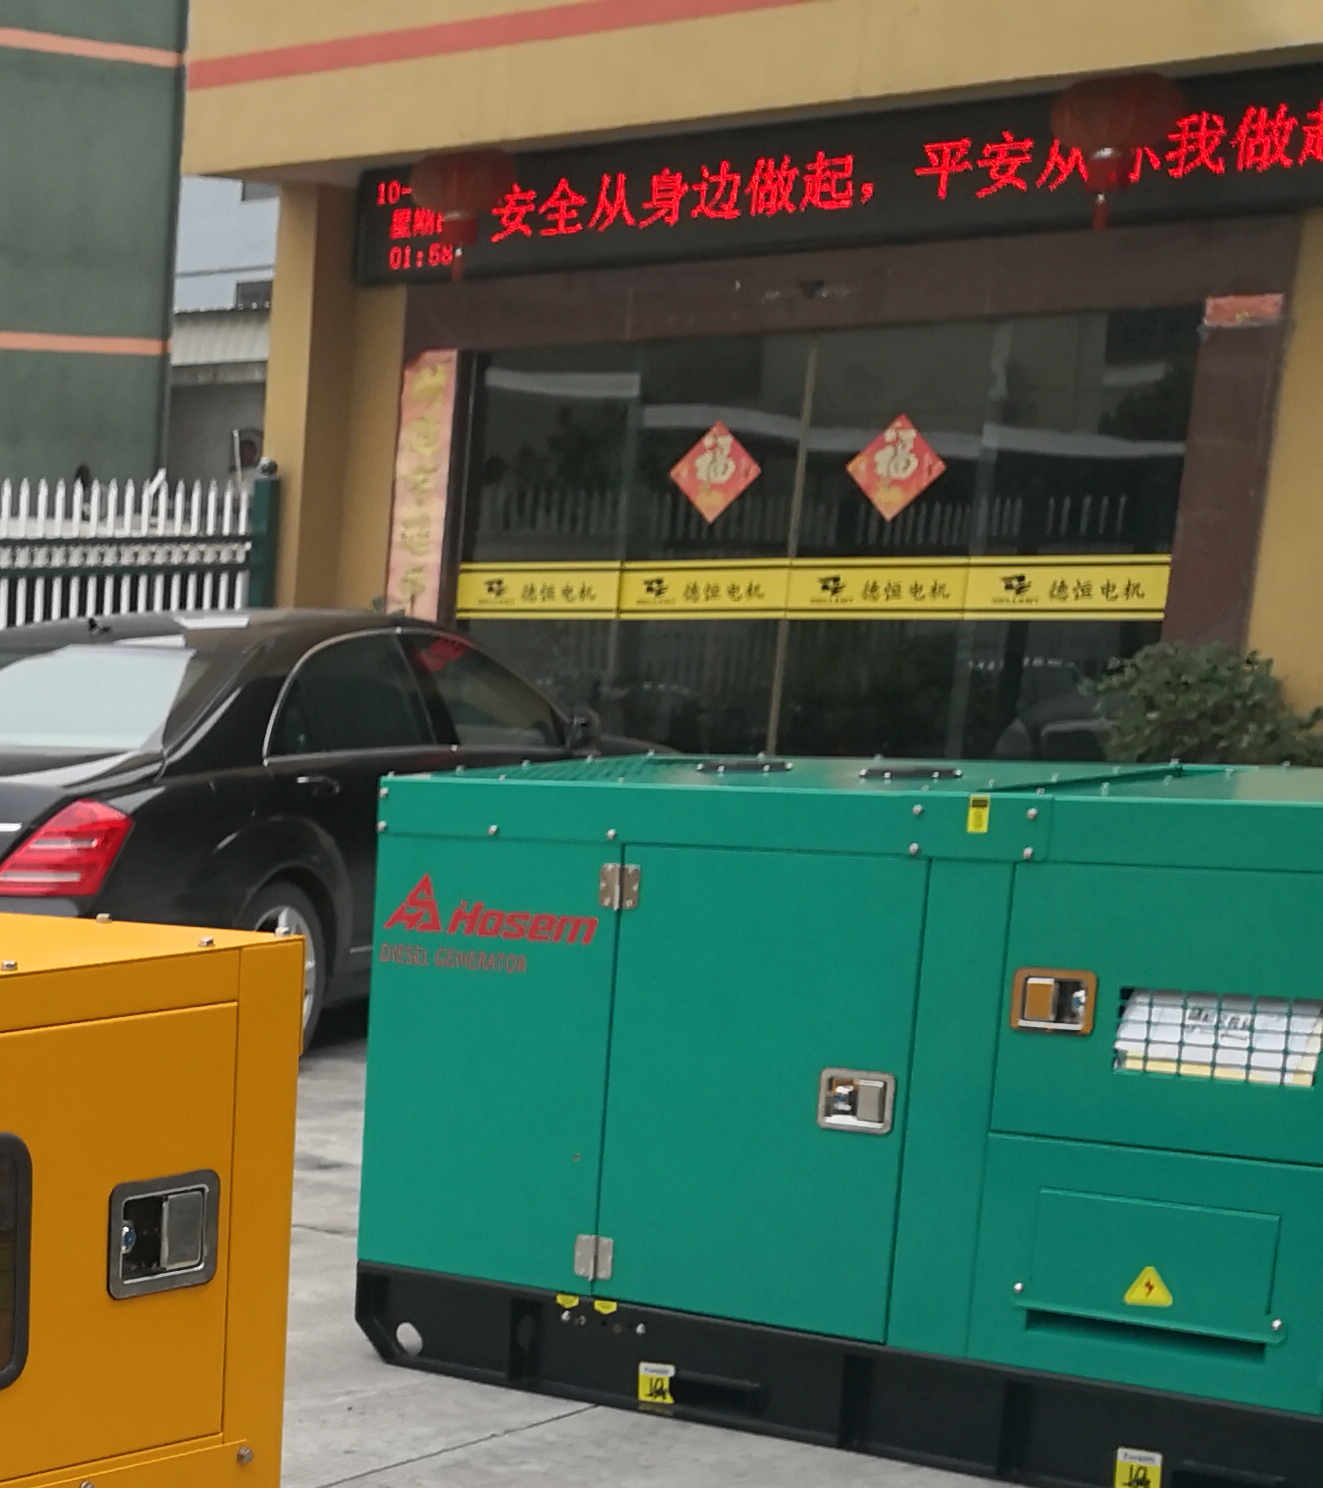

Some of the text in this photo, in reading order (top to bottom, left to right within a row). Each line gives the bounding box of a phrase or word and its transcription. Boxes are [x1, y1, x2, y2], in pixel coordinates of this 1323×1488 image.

[491, 102, 1323, 243] 安全从身边做起，平安从我做
[446, 899, 599, 945] Hosem
[379, 942, 527, 974] DIESEL GENERATOR
